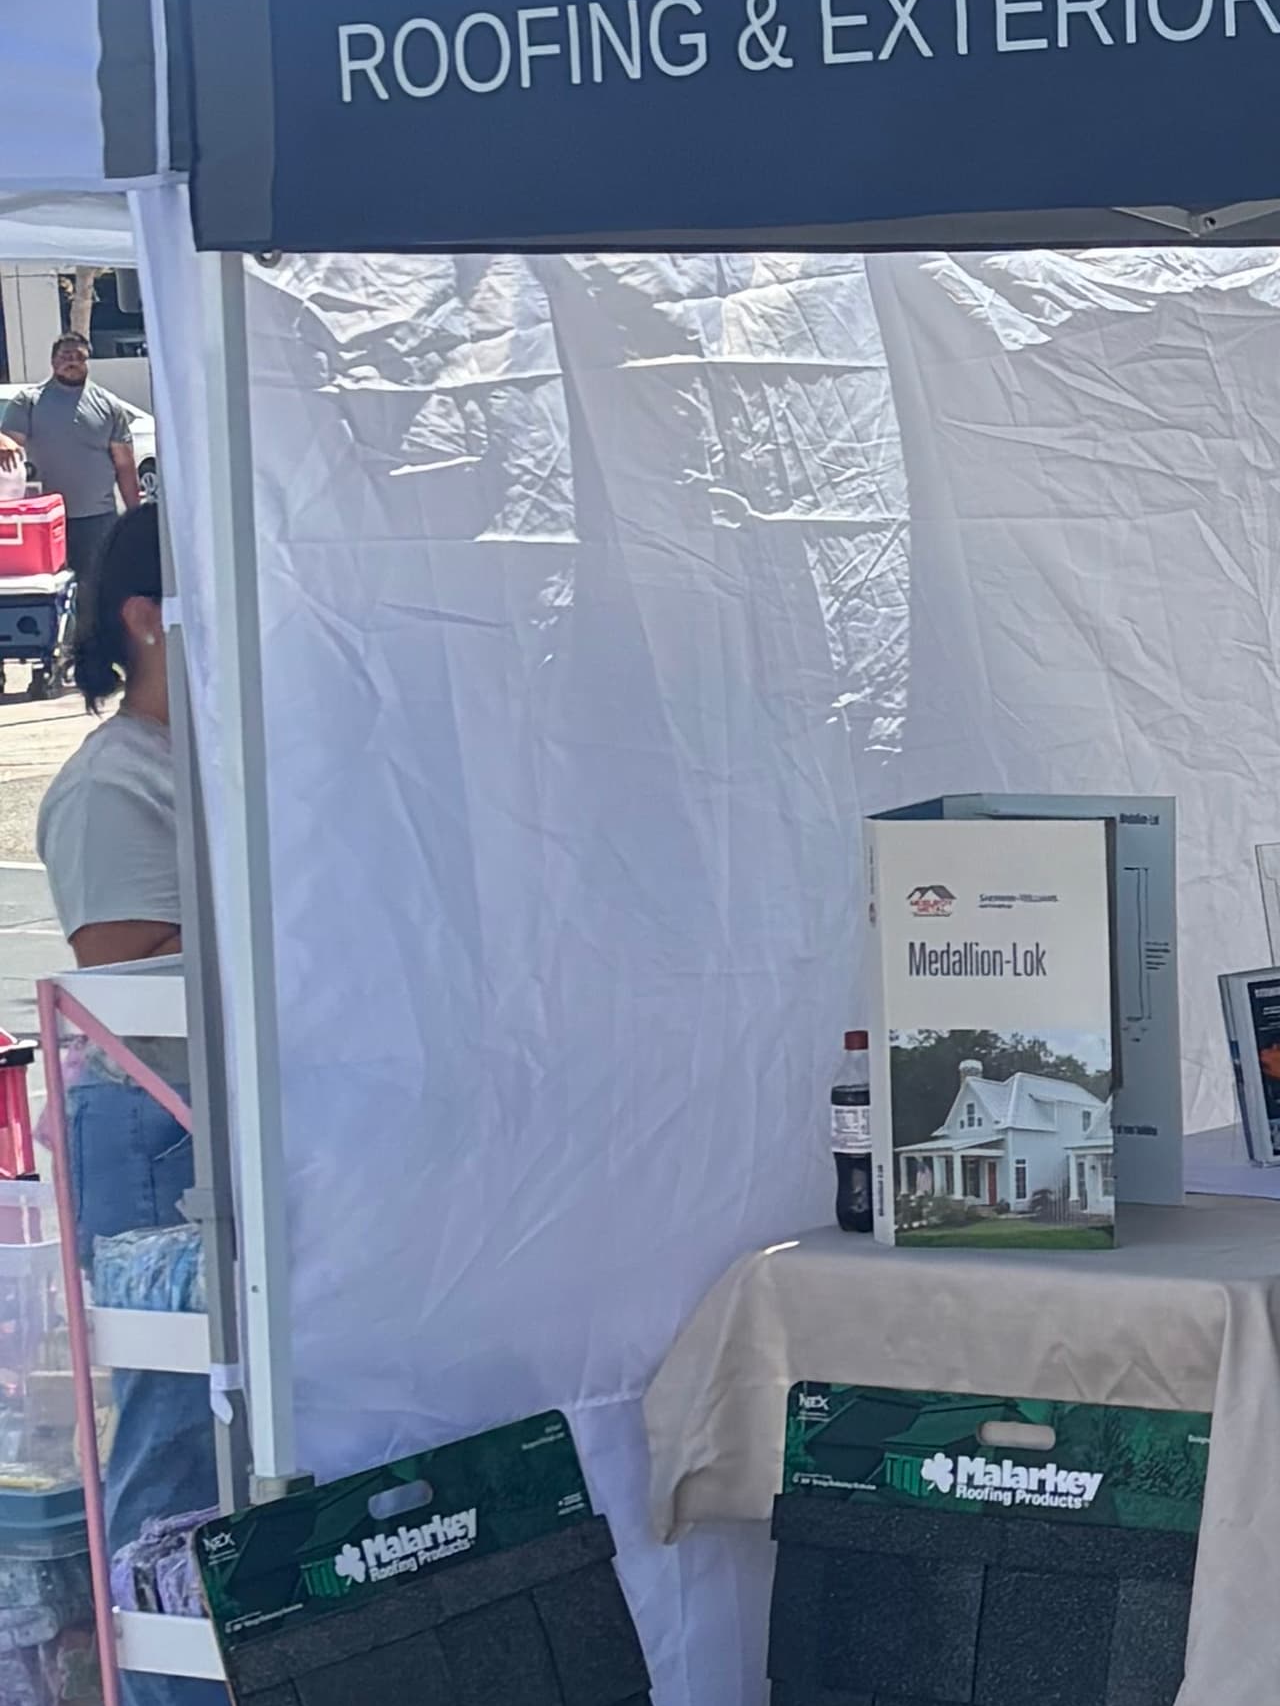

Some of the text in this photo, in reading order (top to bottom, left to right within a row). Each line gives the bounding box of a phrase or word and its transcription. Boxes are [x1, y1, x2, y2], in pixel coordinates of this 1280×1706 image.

[908, 941, 1047, 978] Medallion-Lok
[955, 1484, 1013, 1508] Roofing
[956, 1455, 1103, 1500] Malarkey
[362, 1507, 478, 1569] Malarkey
[370, 1555, 418, 1582] Roofing
